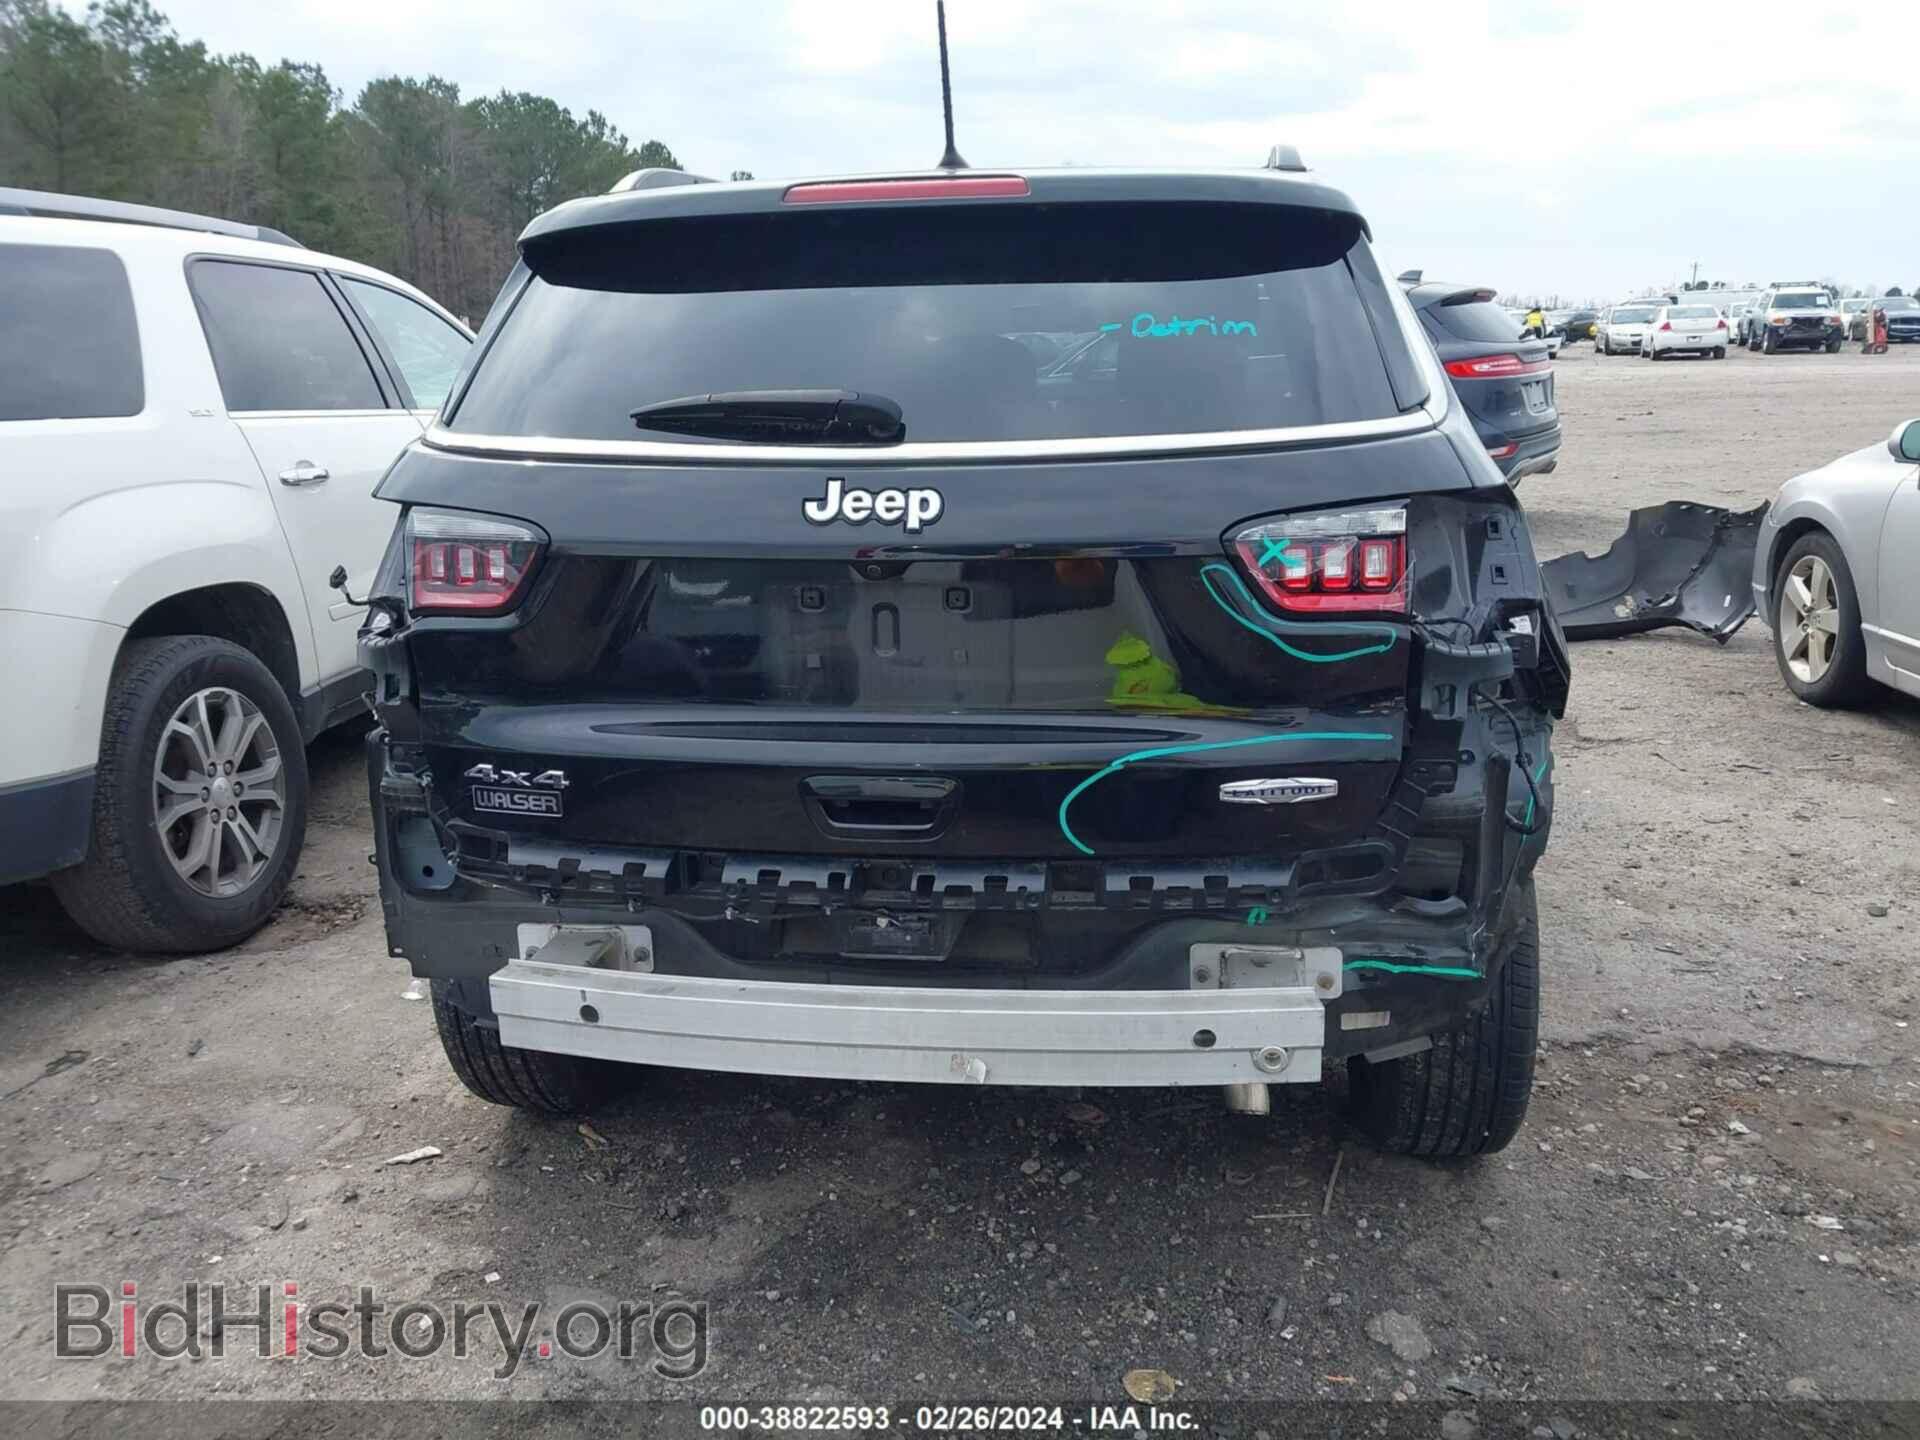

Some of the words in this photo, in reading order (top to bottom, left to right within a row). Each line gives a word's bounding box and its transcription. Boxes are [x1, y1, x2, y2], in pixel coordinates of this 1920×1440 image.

[803, 477, 944, 533] Jeep
[464, 763, 570, 789] 4x4
[476, 790, 558, 812] WALSER
